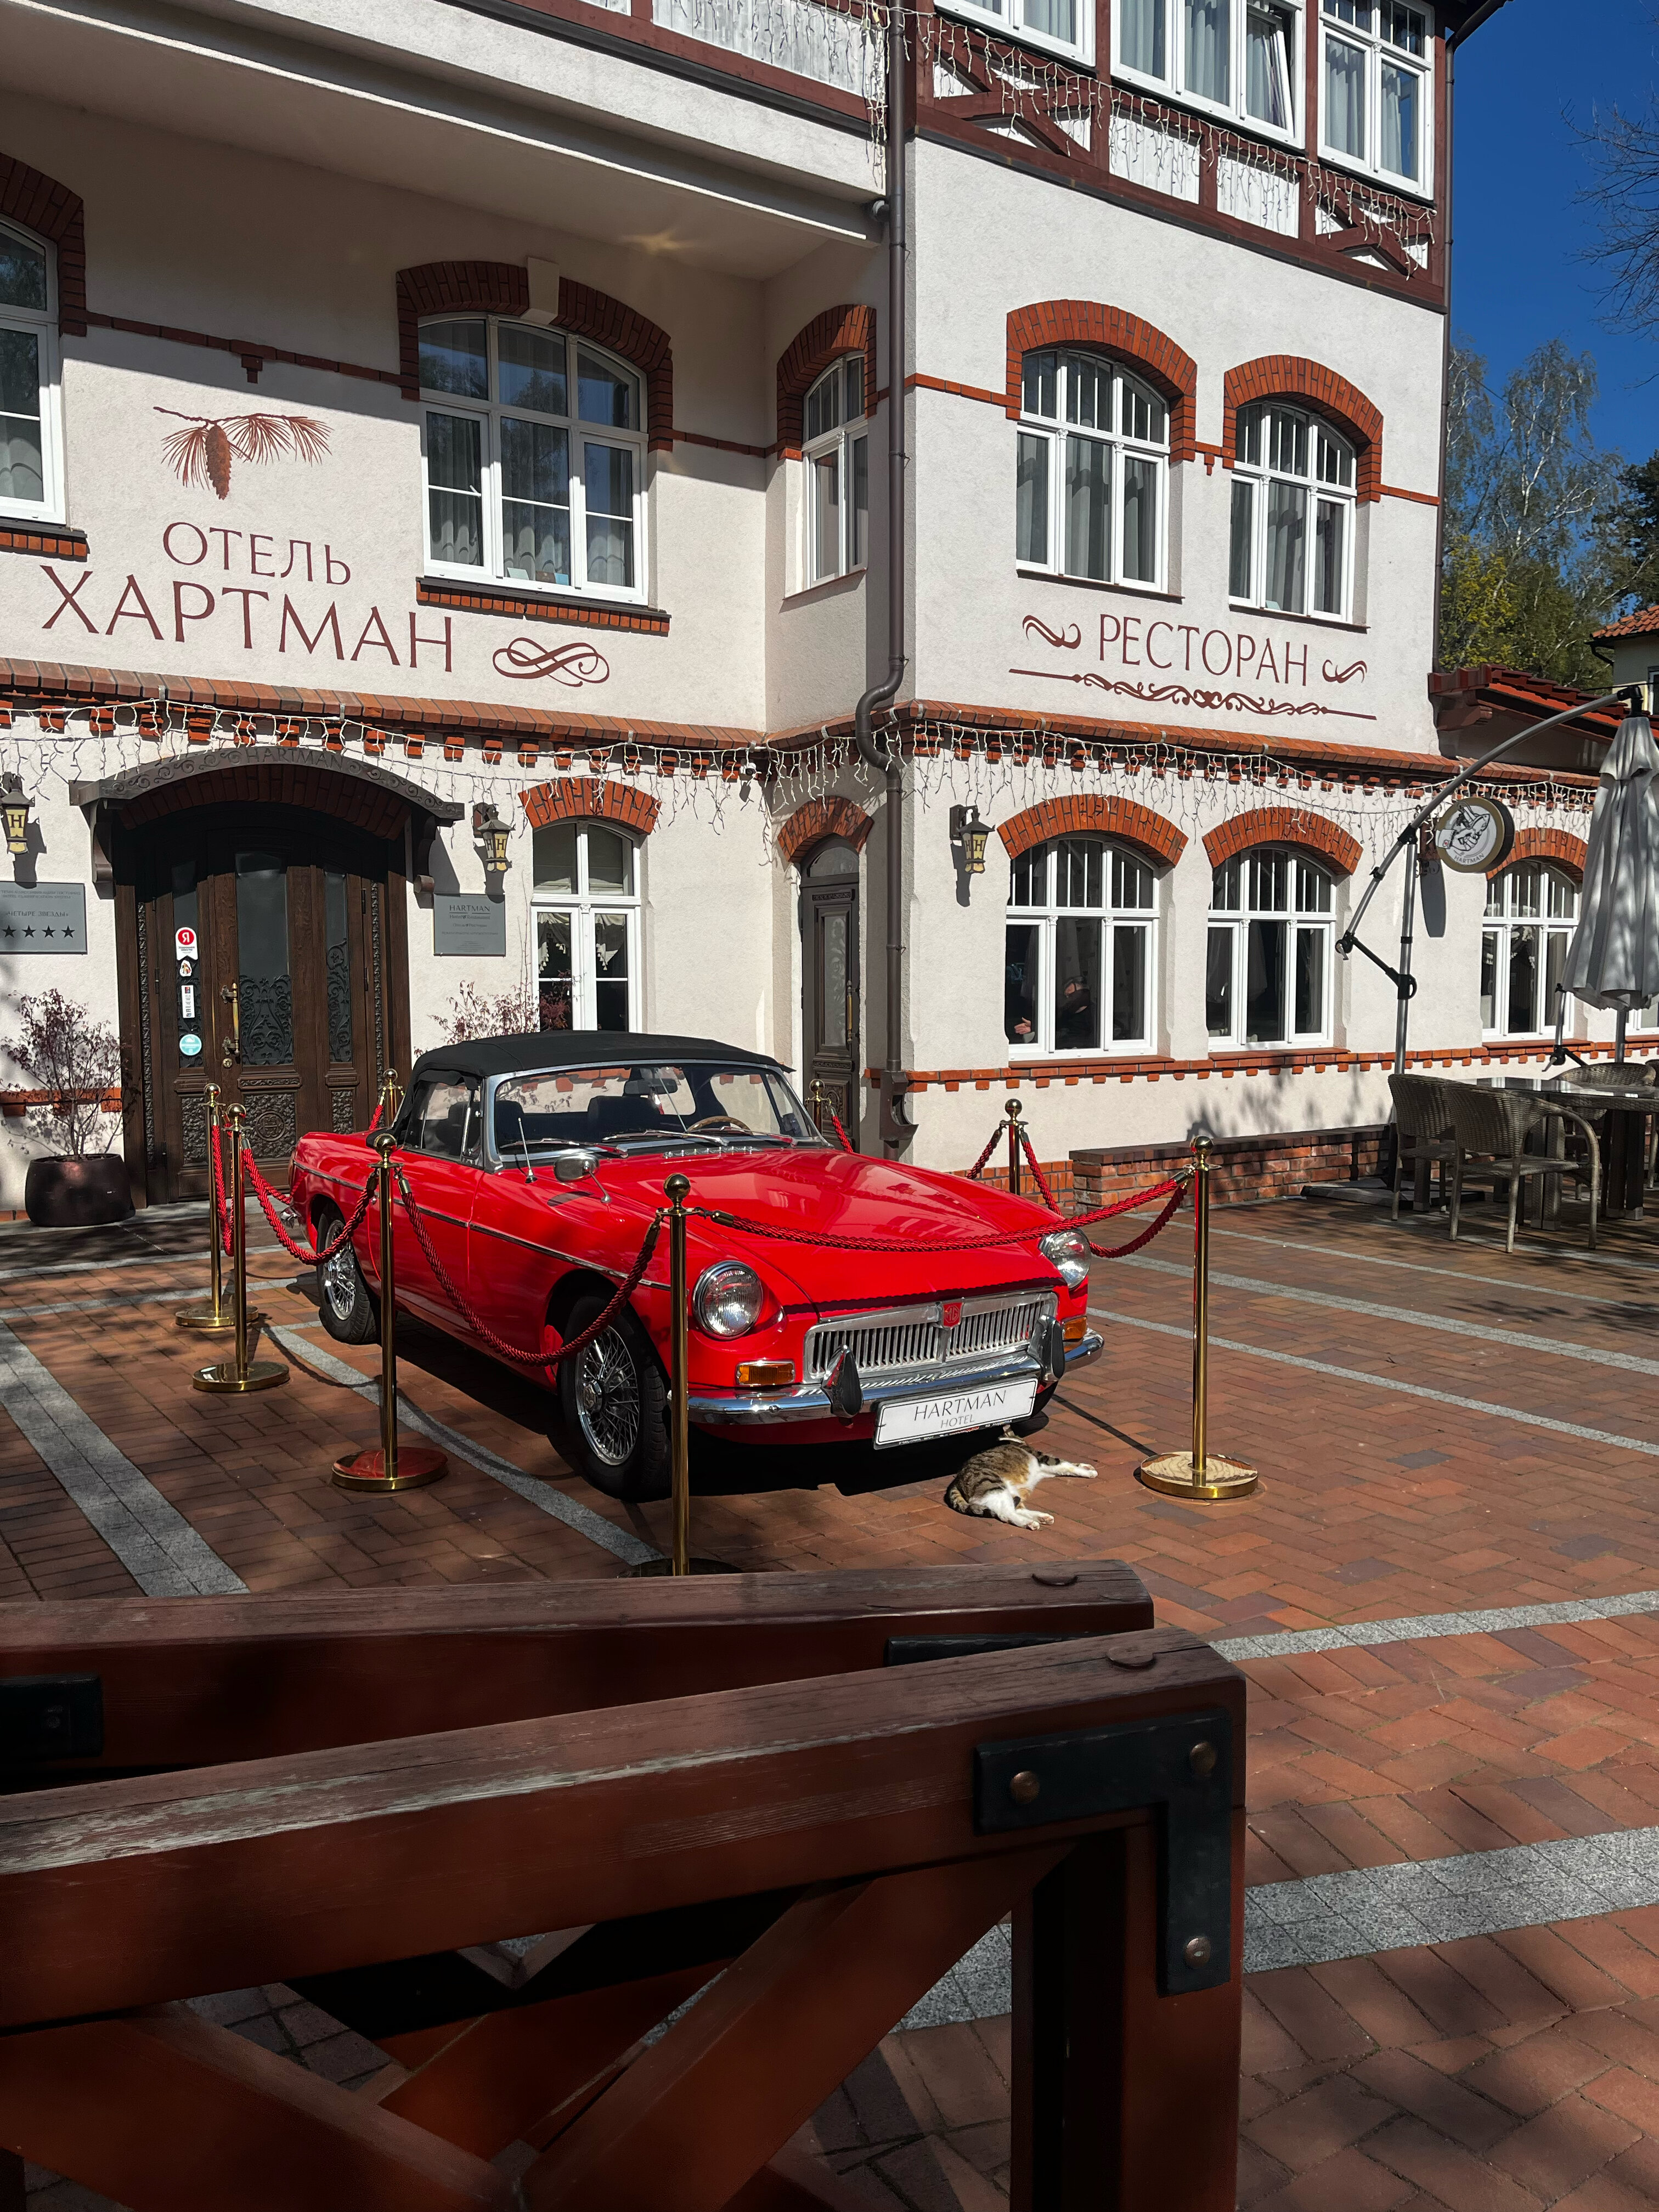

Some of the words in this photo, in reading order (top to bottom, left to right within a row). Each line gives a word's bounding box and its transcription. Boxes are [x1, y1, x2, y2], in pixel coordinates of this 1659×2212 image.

[162, 521, 351, 585] ОТЕЛЬ
[40, 565, 452, 673] ХАРТМАН
[1099, 613, 1308, 686] РЕСТОРАН
[246, 747, 344, 771] HARTMAN
[7, 814, 25, 828] H
[495, 838, 506, 850] H
[973, 839, 985, 851] H
[1454, 853, 1485, 864] HARTMAN
[182, 932, 190, 943] Я
[945, 1306, 960, 1322] MG
[914, 1390, 1007, 1421] HARTMAN
[940, 1414, 975, 1429] HOTEL
